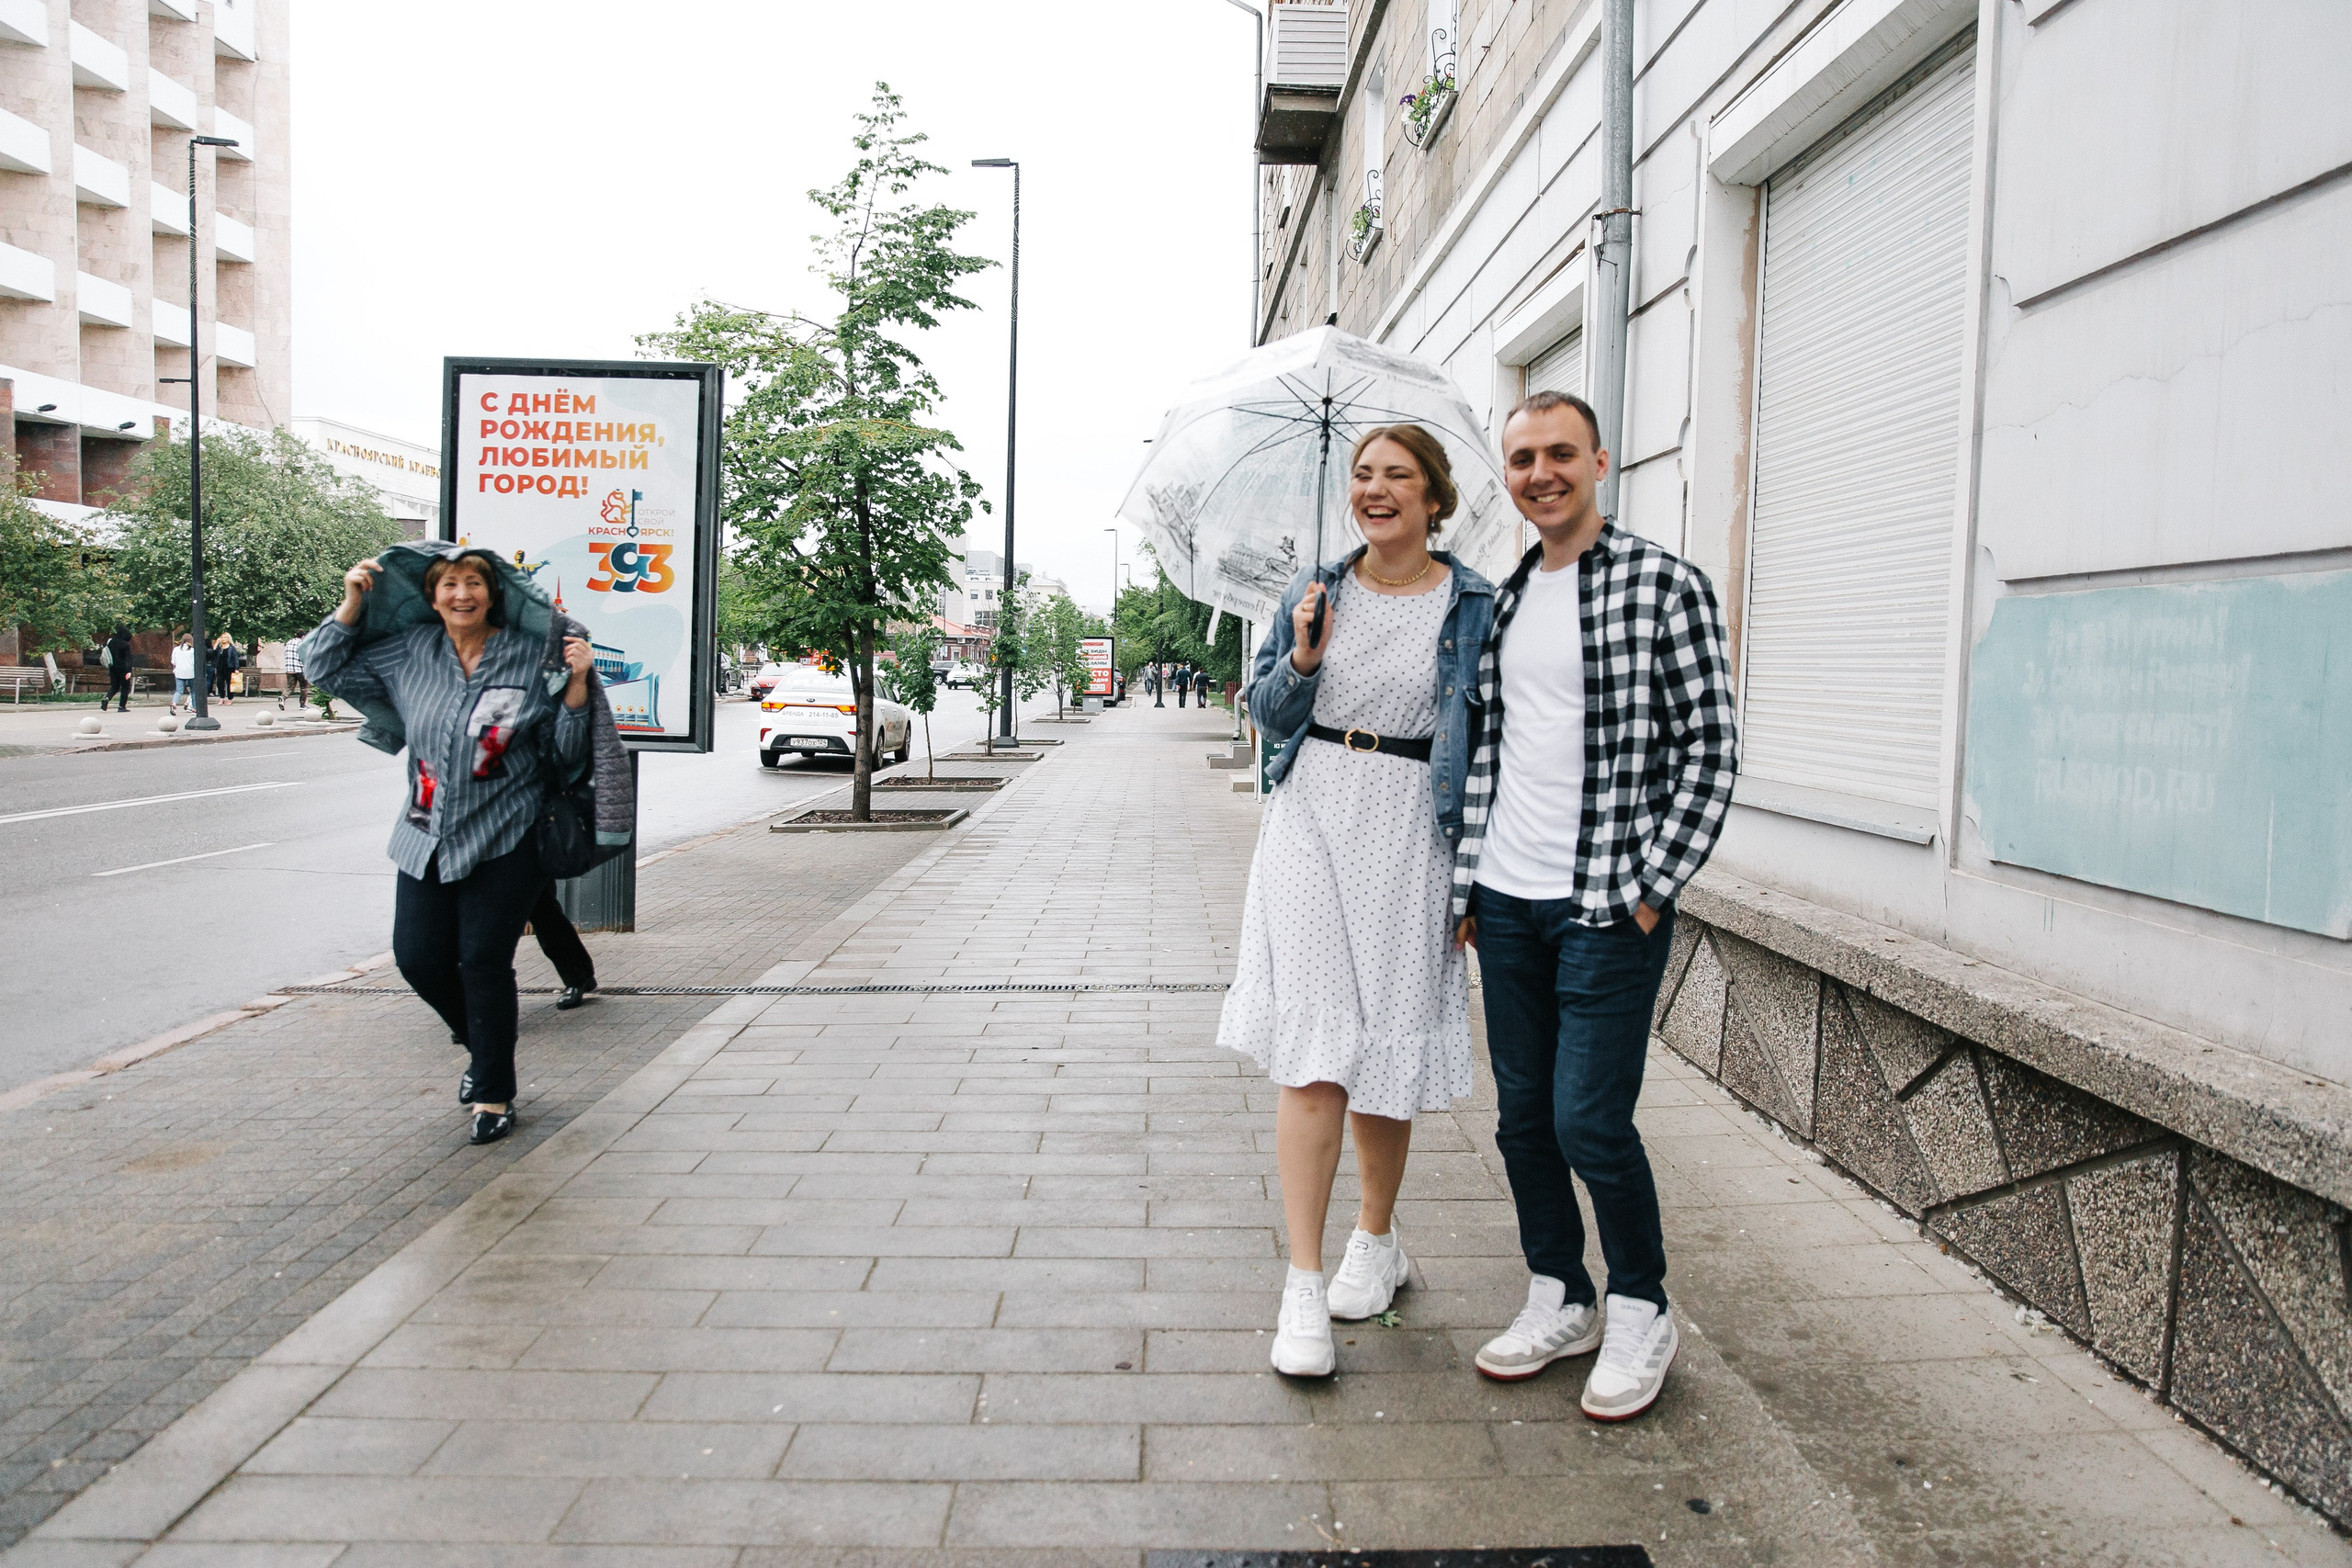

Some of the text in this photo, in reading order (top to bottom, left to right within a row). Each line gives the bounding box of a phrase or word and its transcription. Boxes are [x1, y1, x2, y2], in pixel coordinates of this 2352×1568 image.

[480, 388, 596, 416] С ДНЁМ
[481, 419, 665, 447] РОЖДЕНИЯ,
[326, 437, 441, 479] КРАСНОЯРСКИЙ КРАЕВО
[478, 445, 649, 470] ЛЮБИМЫЙ
[479, 473, 589, 499] ГОРОД!
[638, 508, 675, 516] ОТКРОЙ
[638, 517, 664, 525] СВОЙ
[586, 542, 675, 593] 393
